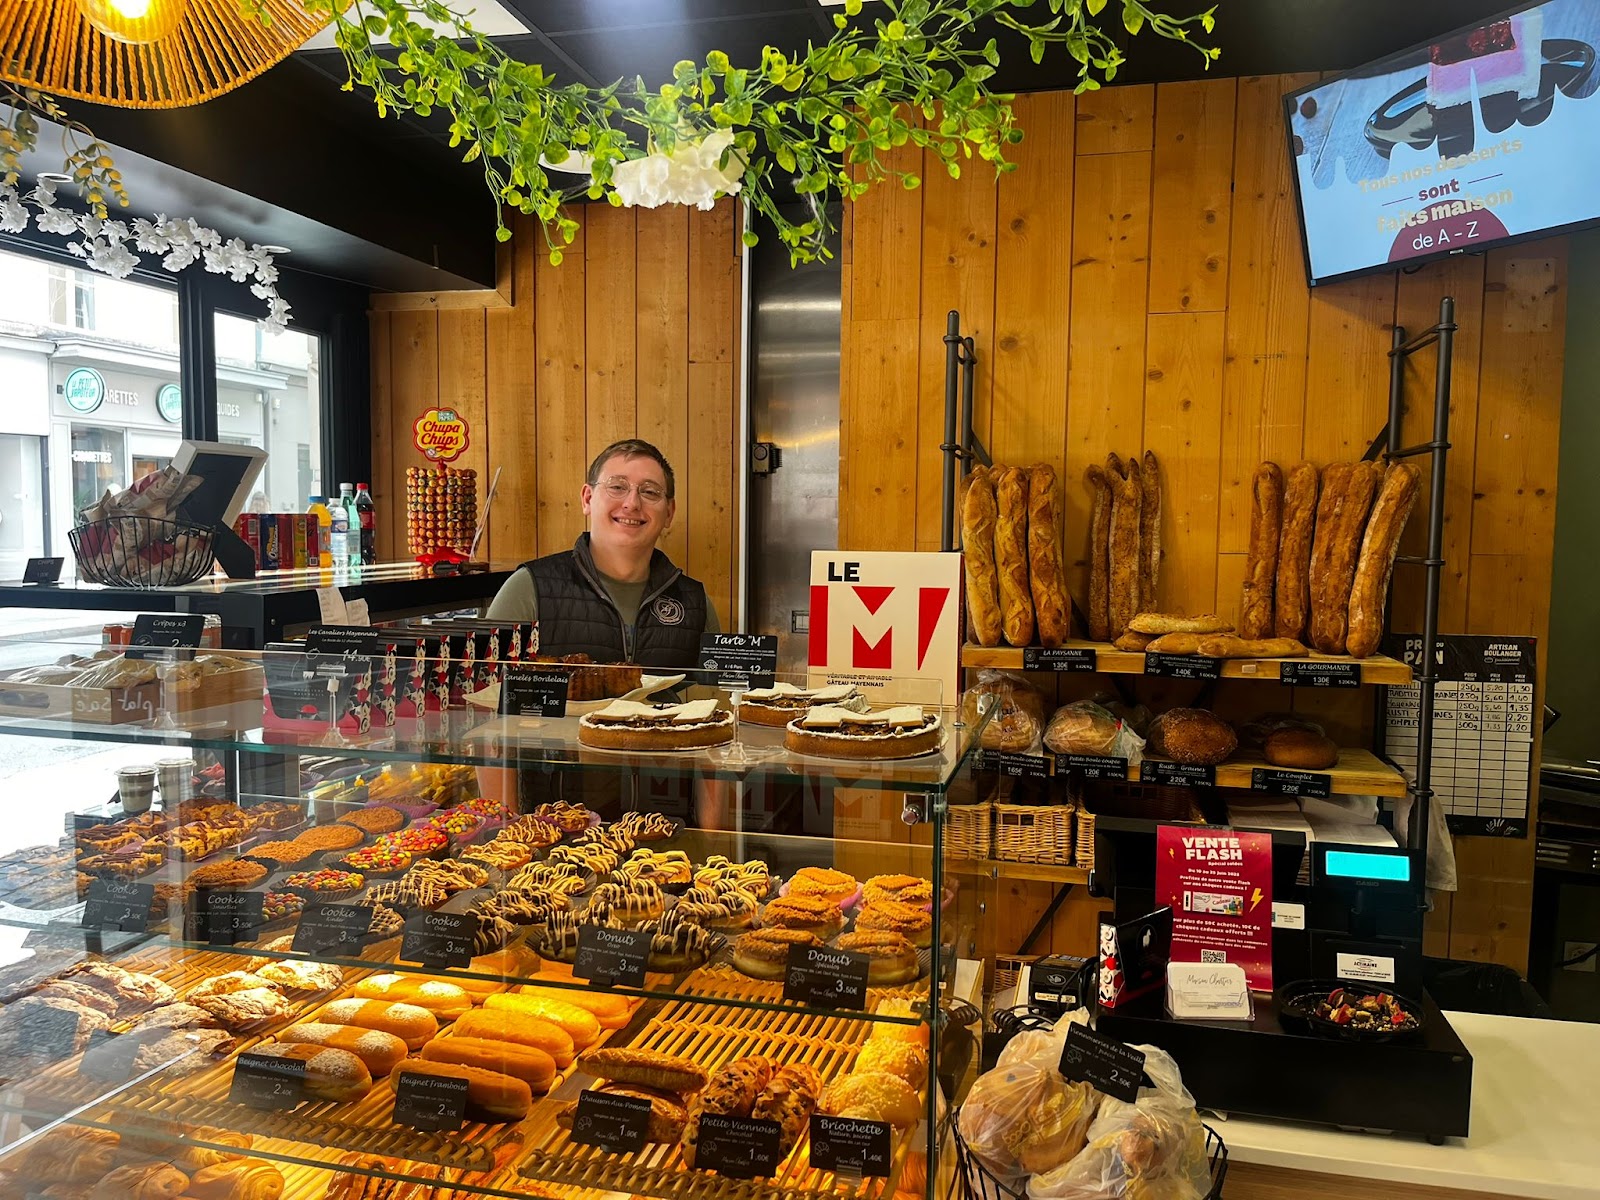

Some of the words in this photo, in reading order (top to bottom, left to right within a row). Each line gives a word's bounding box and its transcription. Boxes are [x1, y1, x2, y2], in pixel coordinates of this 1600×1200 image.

[1358, 175, 1398, 194] Tous
[1402, 163, 1432, 183] nos
[1436, 138, 1523, 172] desserts
[1418, 178, 1460, 201] sont
[1378, 209, 1429, 234] faits
[1432, 187, 1513, 221] maison
[1412, 232, 1433, 250] de
[1437, 228, 1450, 245] A
[1467, 221, 1480, 238] Z
[423, 421, 460, 435] Chupa
[421, 433, 459, 451] Chups
[828, 562, 860, 582] LE
[152, 619, 176, 628] Crêpes
[714, 634, 747, 646] Tarte
[748, 635, 766, 647] "M"
[1404, 650, 1444, 665] PAN
[1484, 650, 1522, 658] BOULANGER
[504, 674, 532, 682] Canelés
[532, 675, 568, 684] Bordelais
[850, 680, 884, 688] MAYENNAIS
[542, 694, 560, 706] 1.00€
[1182, 837, 1240, 848] VENTE
[1185, 849, 1243, 860] FLASH
[106, 884, 139, 896] Cookie
[207, 894, 248, 905] Cookie
[320, 907, 357, 918] Cookie
[232, 918, 252, 929] 3.50€
[425, 914, 462, 928] Cookie
[339, 931, 359, 944] 3.50€
[597, 930, 637, 946] Donuts
[446, 941, 466, 955] 3.50€
[808, 949, 853, 966] Donuts
[619, 959, 640, 973] 3.50€
[836, 979, 858, 995] 3.50€
[238, 1056, 268, 1068] Beignet
[269, 1061, 305, 1072] Chocolat
[1126, 1052, 1144, 1064] Veille
[401, 1076, 429, 1087] Beignet
[1109, 1069, 1131, 1089] 2.50€
[274, 1083, 293, 1096] 2.40€
[580, 1094, 610, 1105] Chausson
[624, 1102, 650, 1112] Pommes
[437, 1104, 457, 1117] 2.10€
[702, 1117, 731, 1128] Petite
[732, 1120, 779, 1135] Viennoise
[820, 1118, 884, 1135] Briochette
[726, 1130, 754, 1138] Chocolat
[861, 1148, 882, 1162] 1.40€
